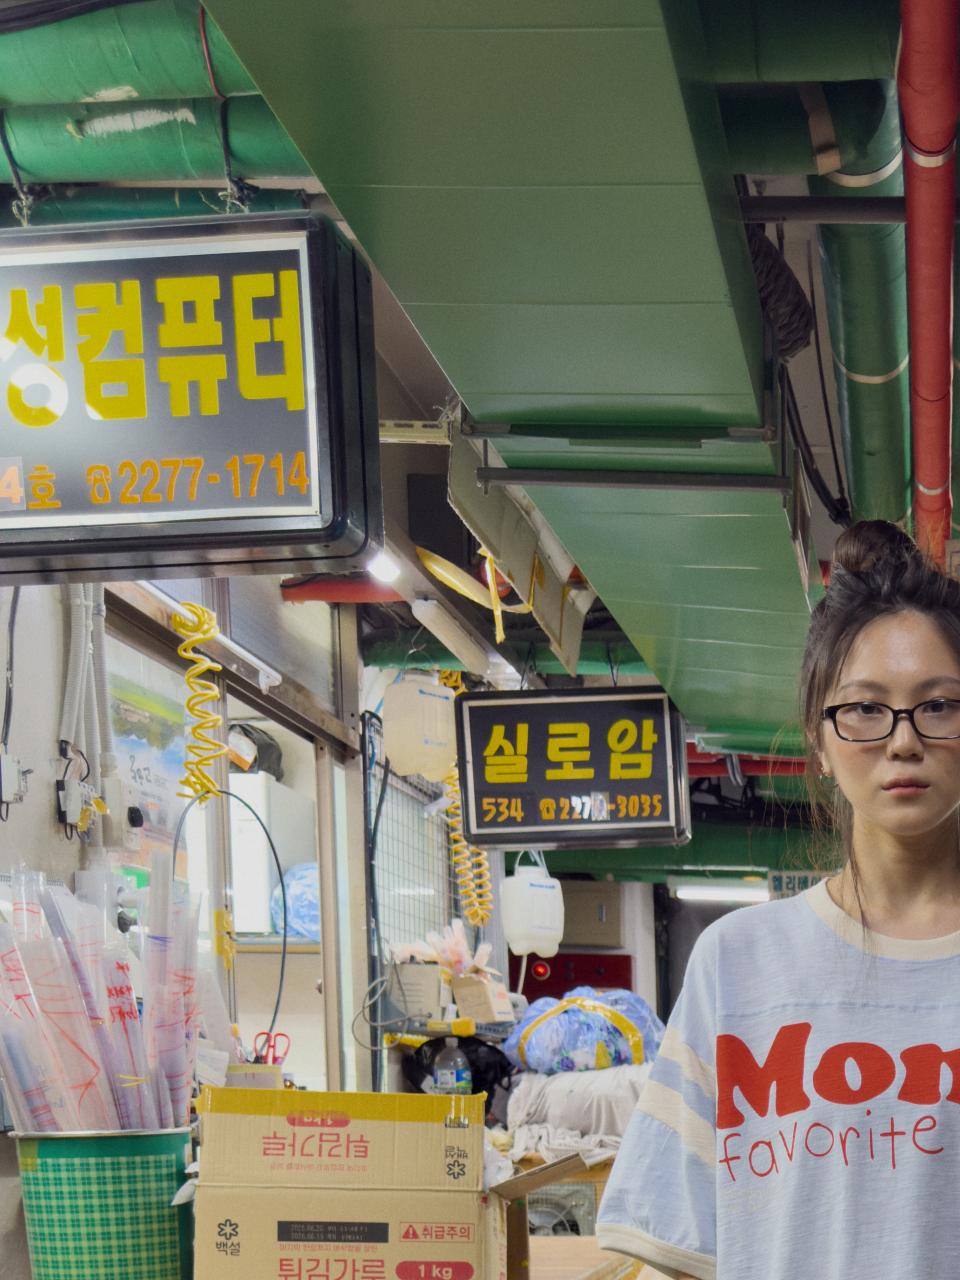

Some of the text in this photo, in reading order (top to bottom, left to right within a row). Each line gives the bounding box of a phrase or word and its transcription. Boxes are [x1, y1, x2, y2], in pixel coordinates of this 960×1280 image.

[0, 270, 306, 428] 성컴퓨터
[117, 452, 310, 504] 2277-1714
[483, 719, 658, 783] 실로암
[481, 796, 524, 822] 534
[719, 1110, 944, 1182] favorite
[215, 1241, 241, 1256] 백설
[421, 1225, 471, 1240] 취급주의
[432, 1264, 453, 1280] kg
